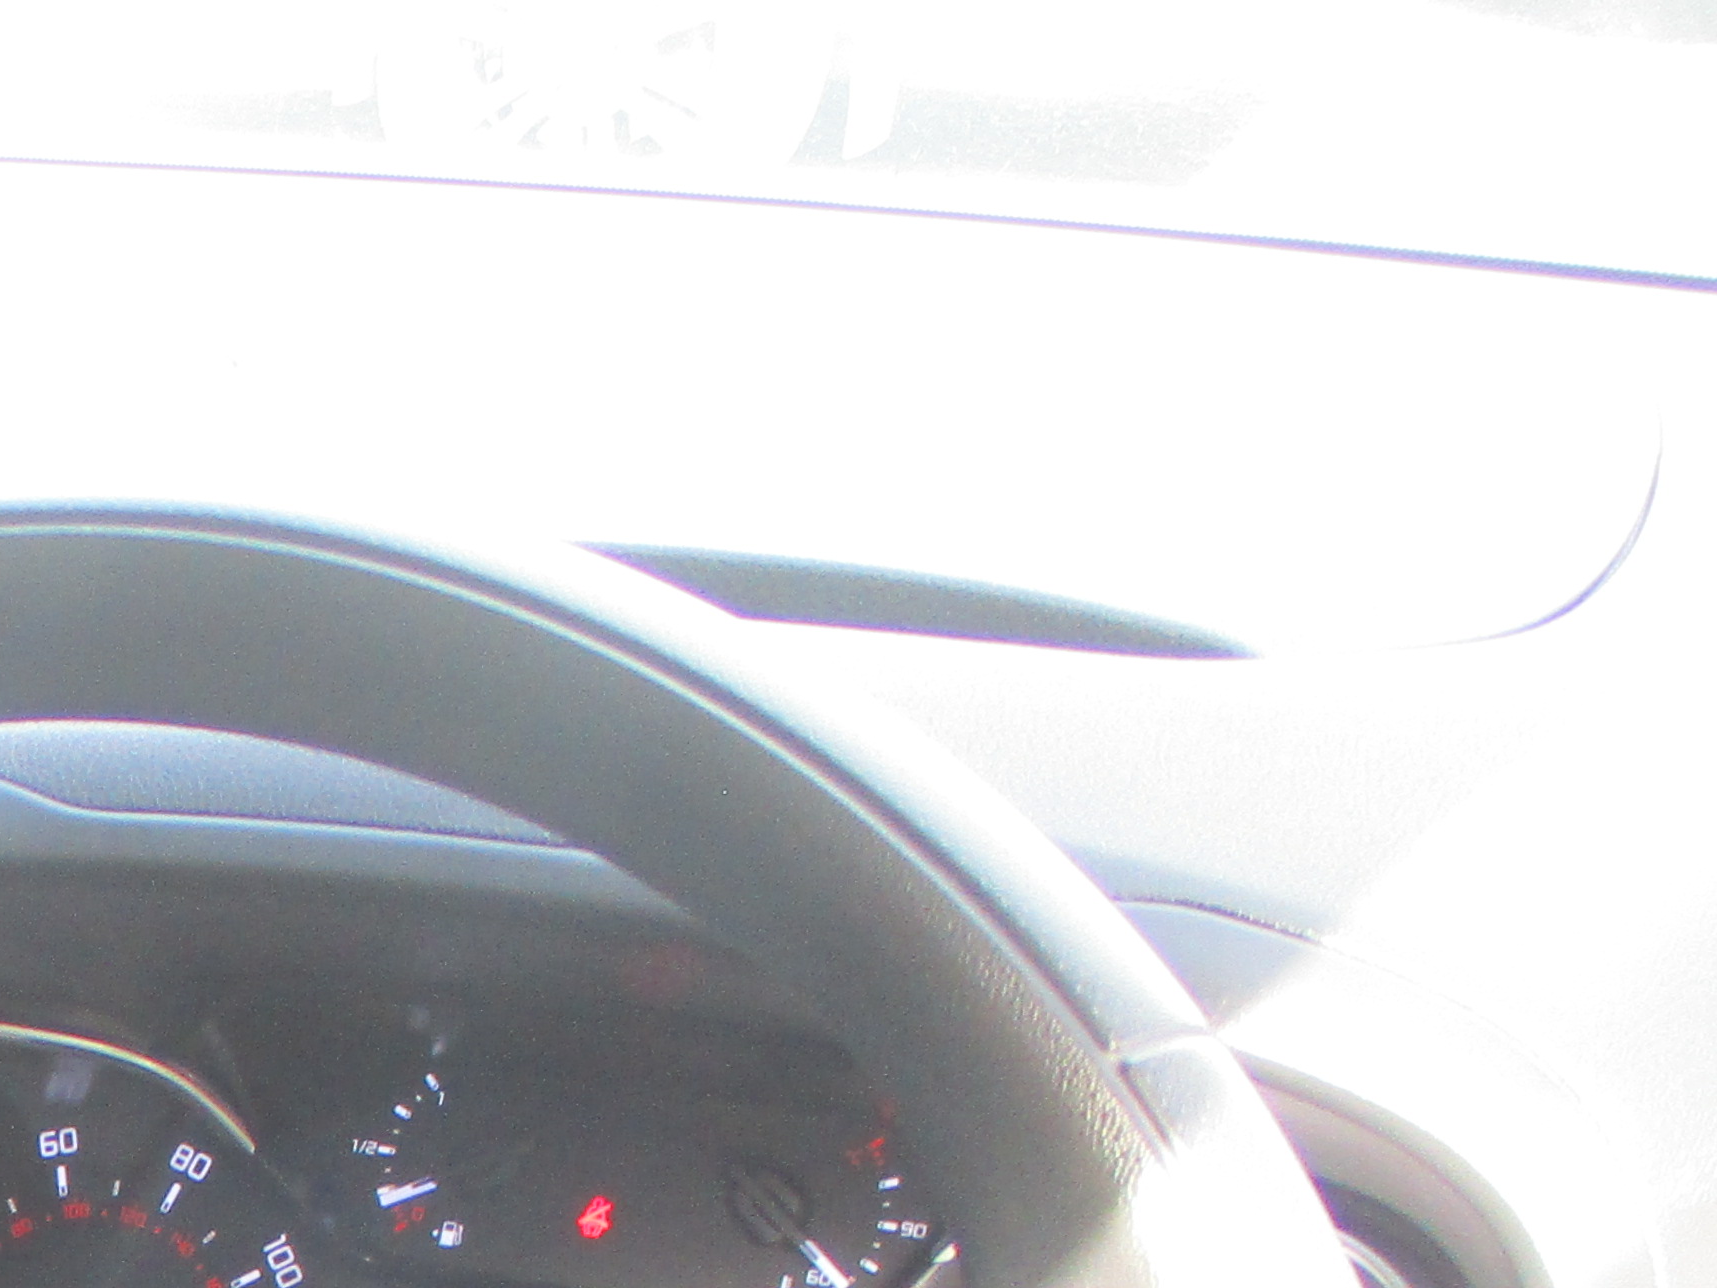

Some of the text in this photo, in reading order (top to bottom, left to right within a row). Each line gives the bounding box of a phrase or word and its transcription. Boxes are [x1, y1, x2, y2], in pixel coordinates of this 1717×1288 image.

[38, 1126, 78, 1158] 60
[168, 1142, 212, 1183] 80
[900, 1220, 929, 1240] 90
